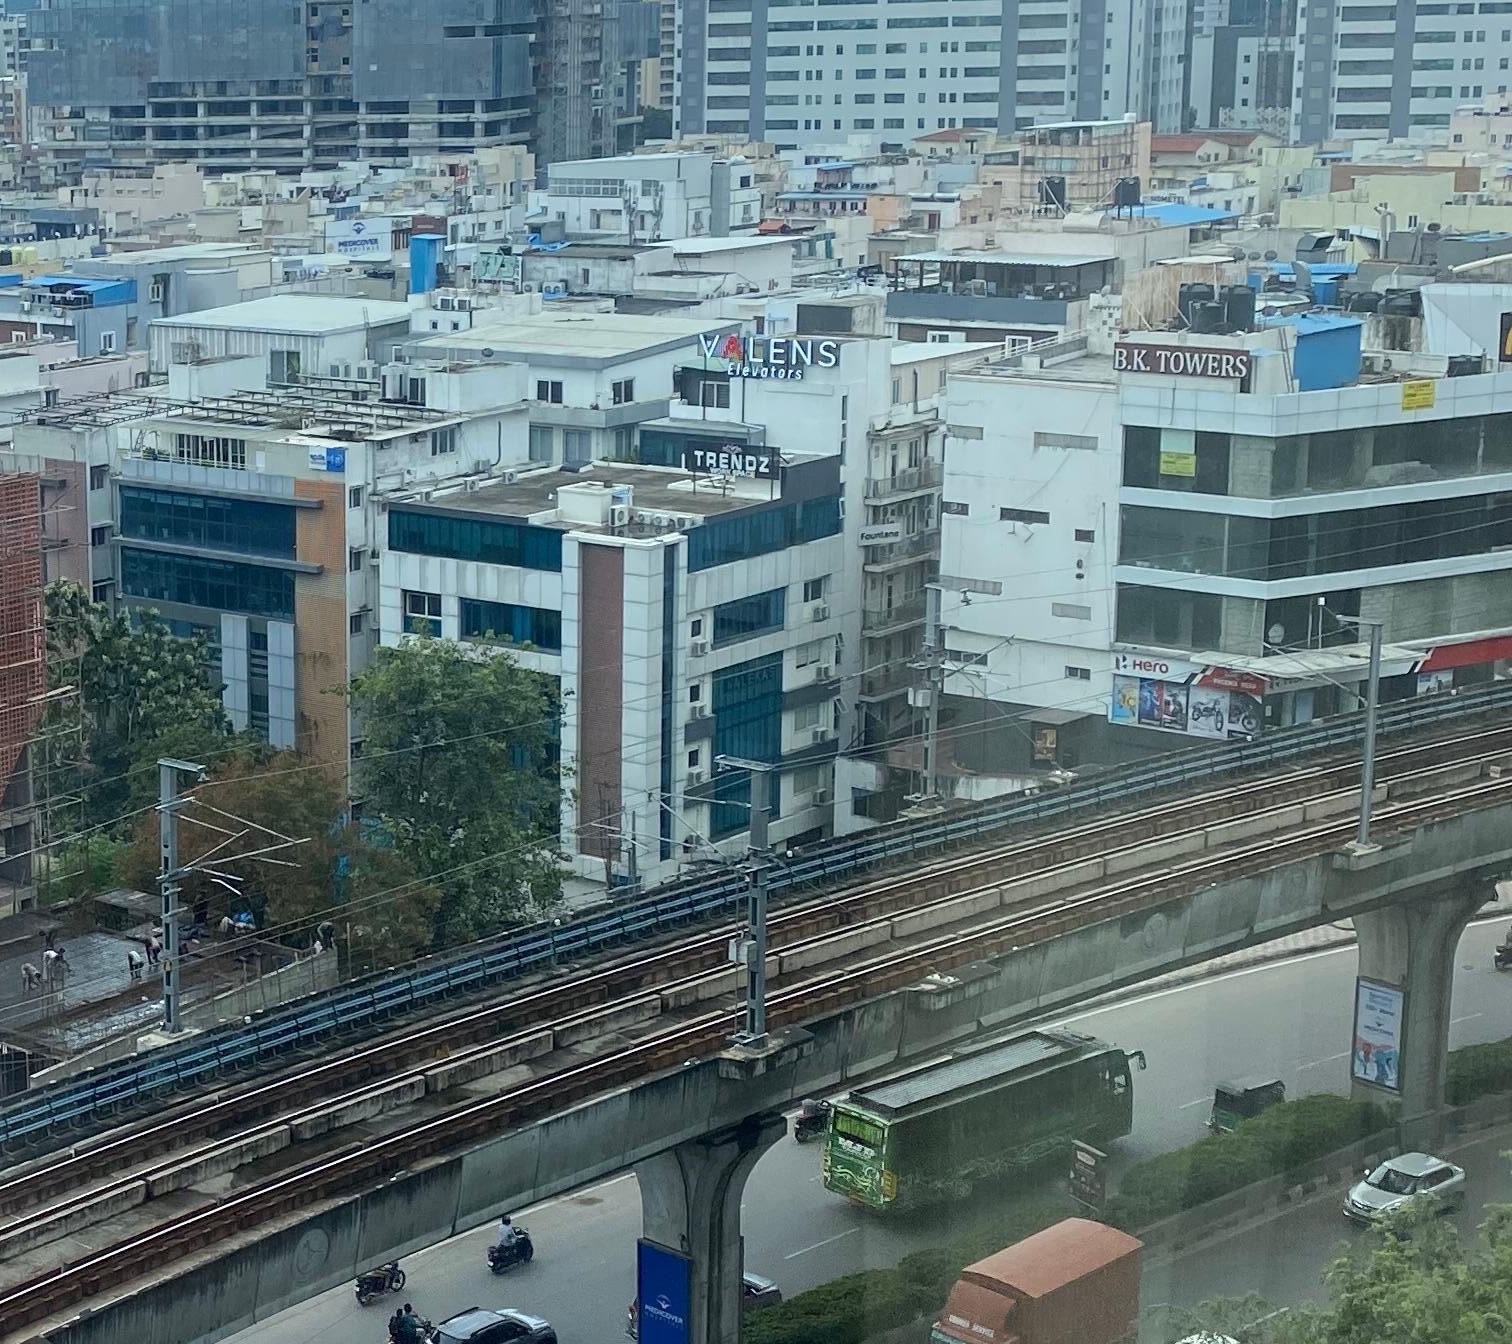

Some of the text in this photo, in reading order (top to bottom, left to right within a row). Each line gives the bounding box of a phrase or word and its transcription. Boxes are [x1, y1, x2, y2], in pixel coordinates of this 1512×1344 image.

[727, 363, 803, 380] Elevators
[1114, 348, 1248, 378] B.K. TOWERS
[694, 450, 770, 473] TRENDZ
